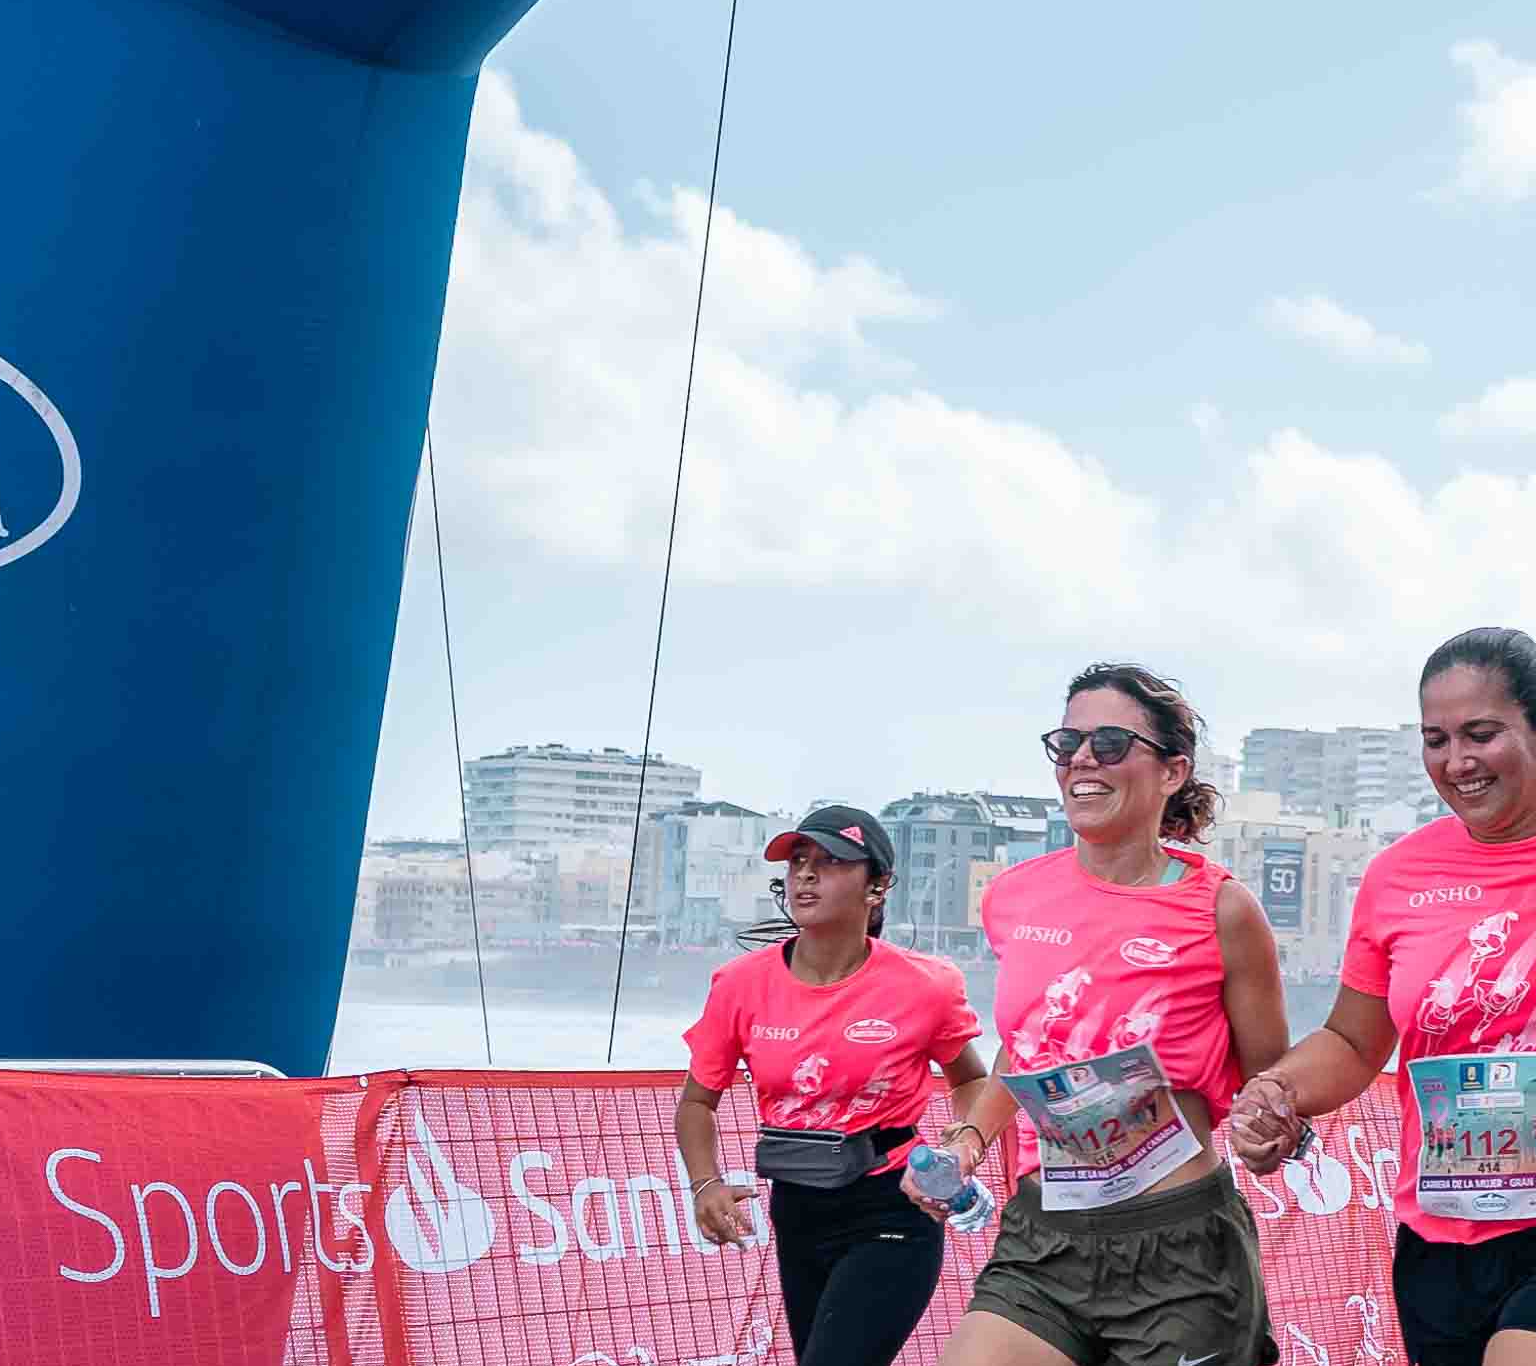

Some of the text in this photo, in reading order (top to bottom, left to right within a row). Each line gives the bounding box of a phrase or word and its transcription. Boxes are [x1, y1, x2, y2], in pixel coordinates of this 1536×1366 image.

[1409, 884, 1482, 908] OYSHO
[1459, 1129, 1521, 1157] 112
[46, 1147, 374, 1318] Sports
